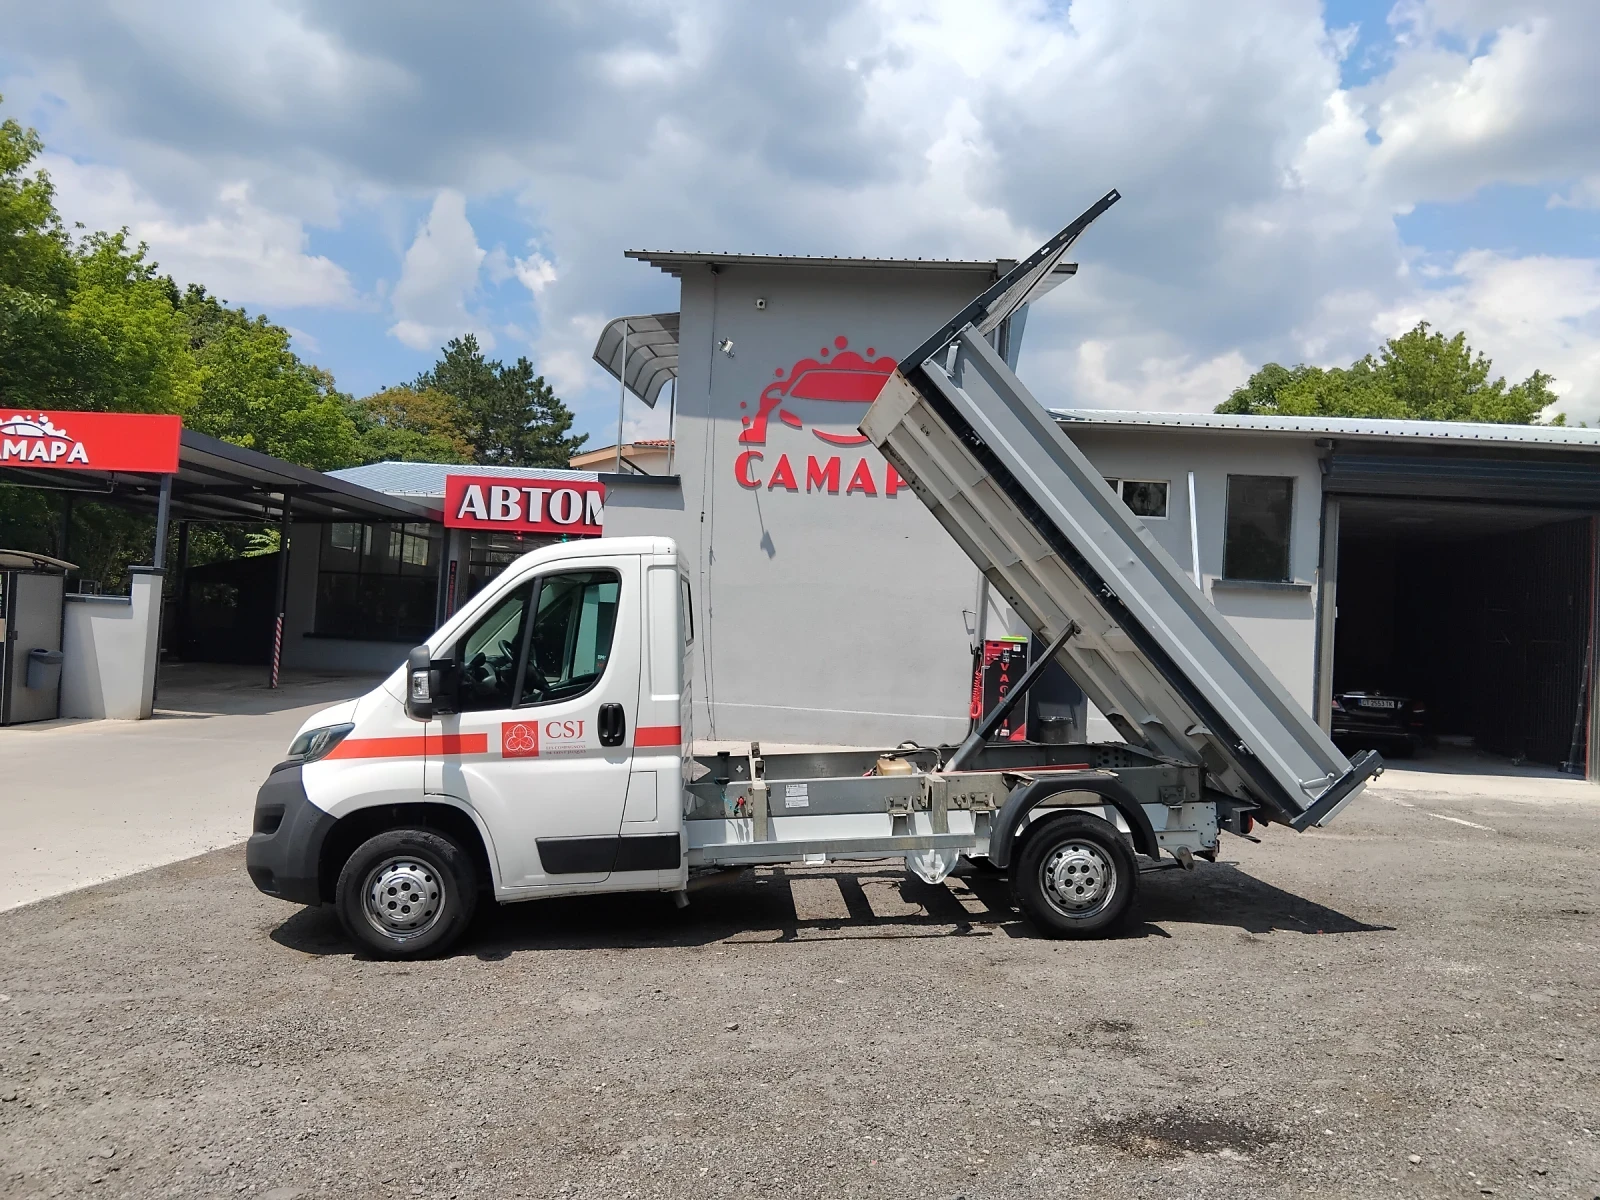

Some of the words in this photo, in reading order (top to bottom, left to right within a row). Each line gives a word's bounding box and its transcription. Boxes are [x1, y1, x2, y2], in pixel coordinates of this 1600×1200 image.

[0, 439, 90, 464] МАРА
[734, 450, 908, 495] САМАР
[545, 720, 585, 739] CSJ
